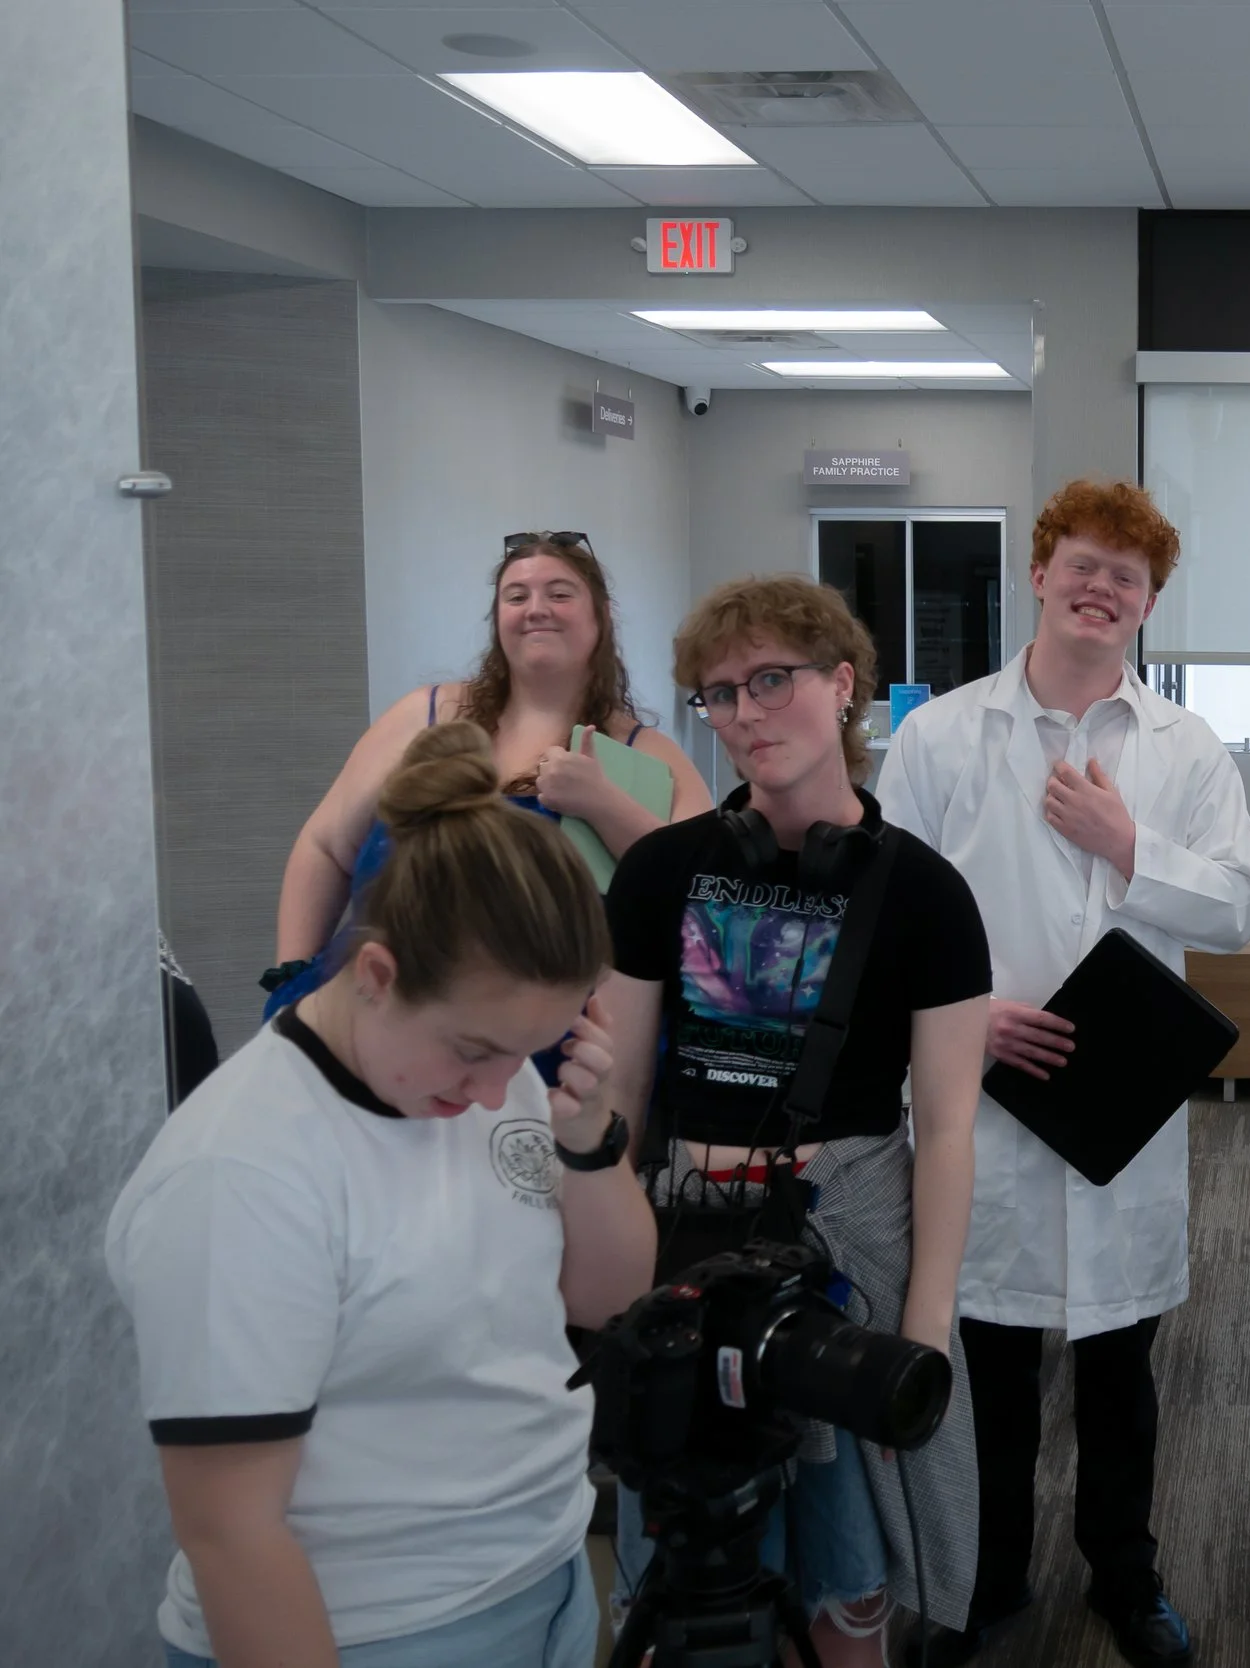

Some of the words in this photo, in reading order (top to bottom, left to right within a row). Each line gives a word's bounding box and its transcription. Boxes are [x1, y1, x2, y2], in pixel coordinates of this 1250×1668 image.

[661, 222, 720, 269] EXIT
[600, 405, 626, 425] Deliveries
[813, 467, 848, 476] FAMILY
[850, 467, 900, 477] PRACTICE
[831, 457, 881, 467] SAPPHIRE
[706, 1068, 779, 1088] DISCOVER
